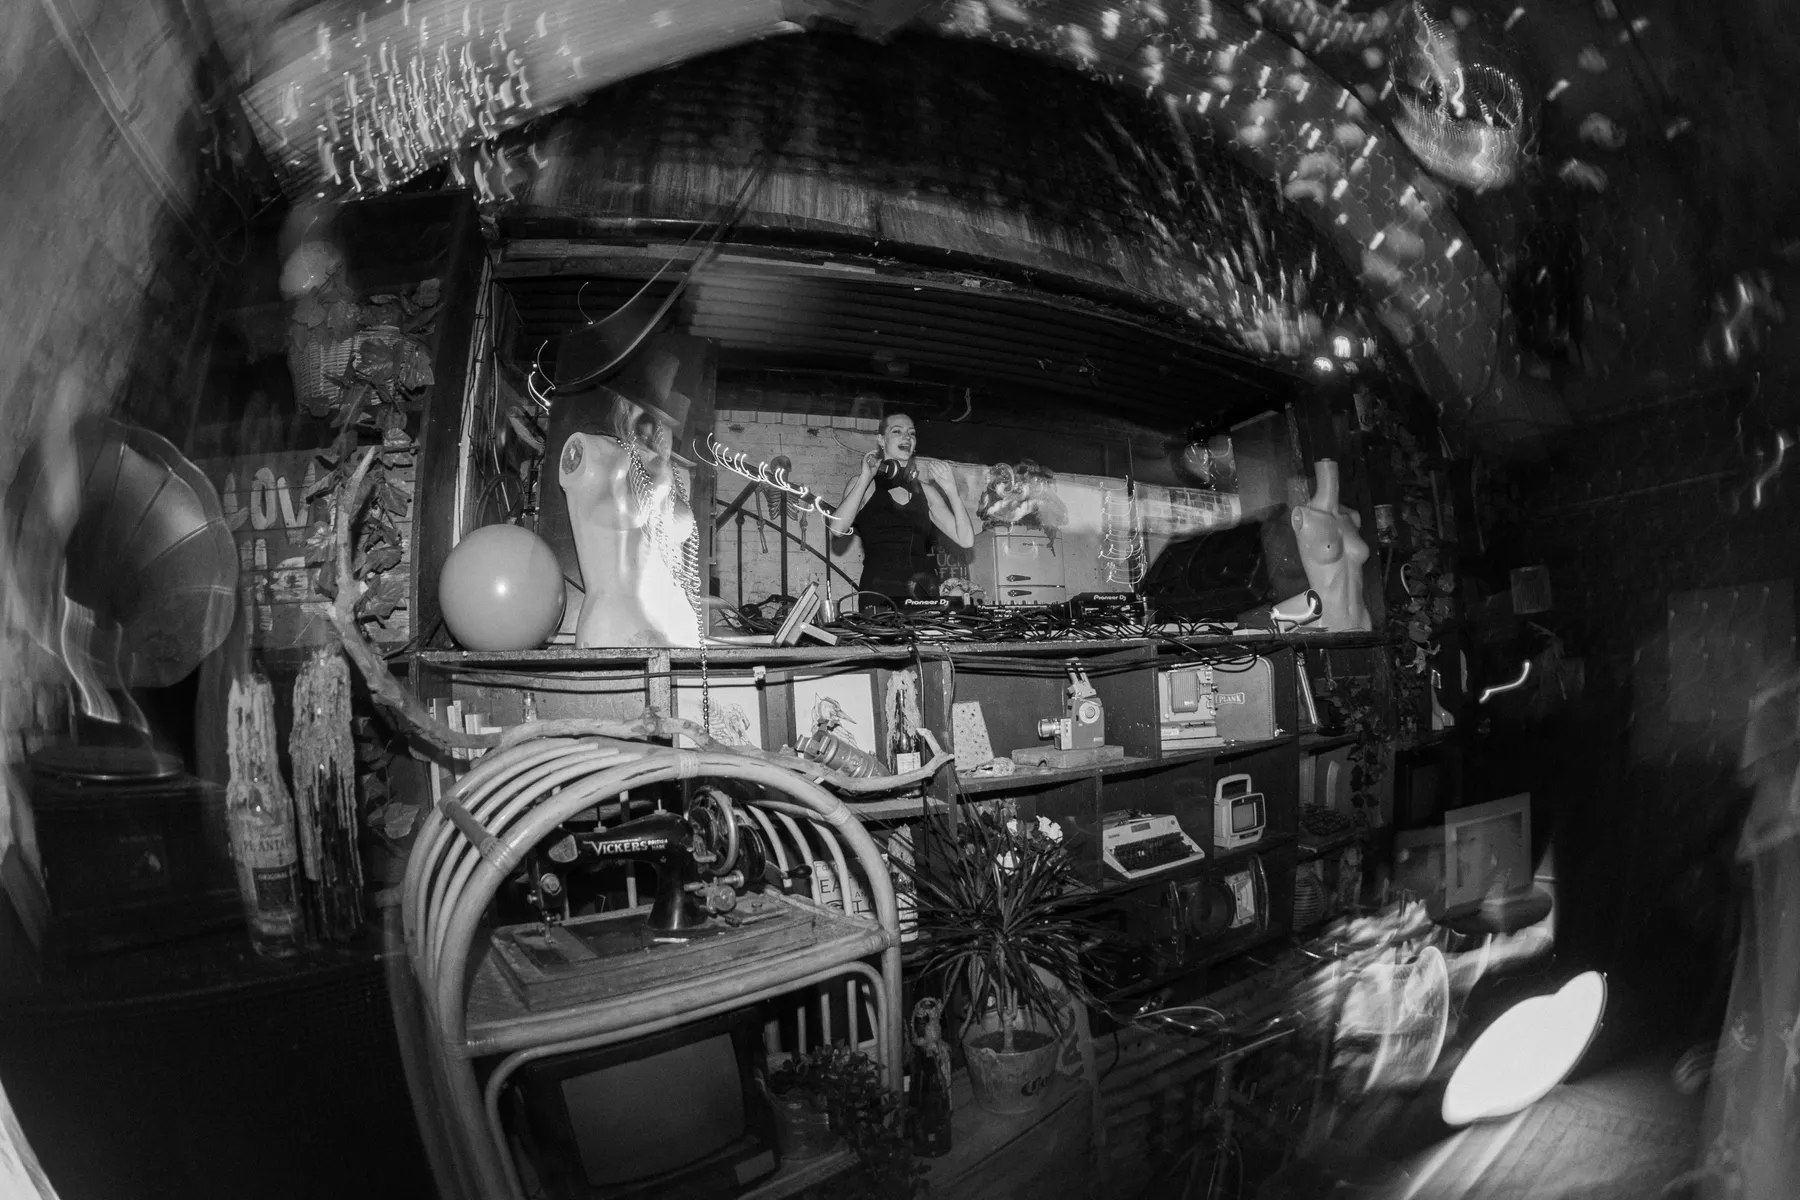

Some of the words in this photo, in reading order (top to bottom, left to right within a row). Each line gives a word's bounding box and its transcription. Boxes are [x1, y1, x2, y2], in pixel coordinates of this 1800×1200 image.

[224, 460, 318, 545] LOV
[904, 598, 939, 606] Pioneer
[583, 838, 648, 856] VICKERS
